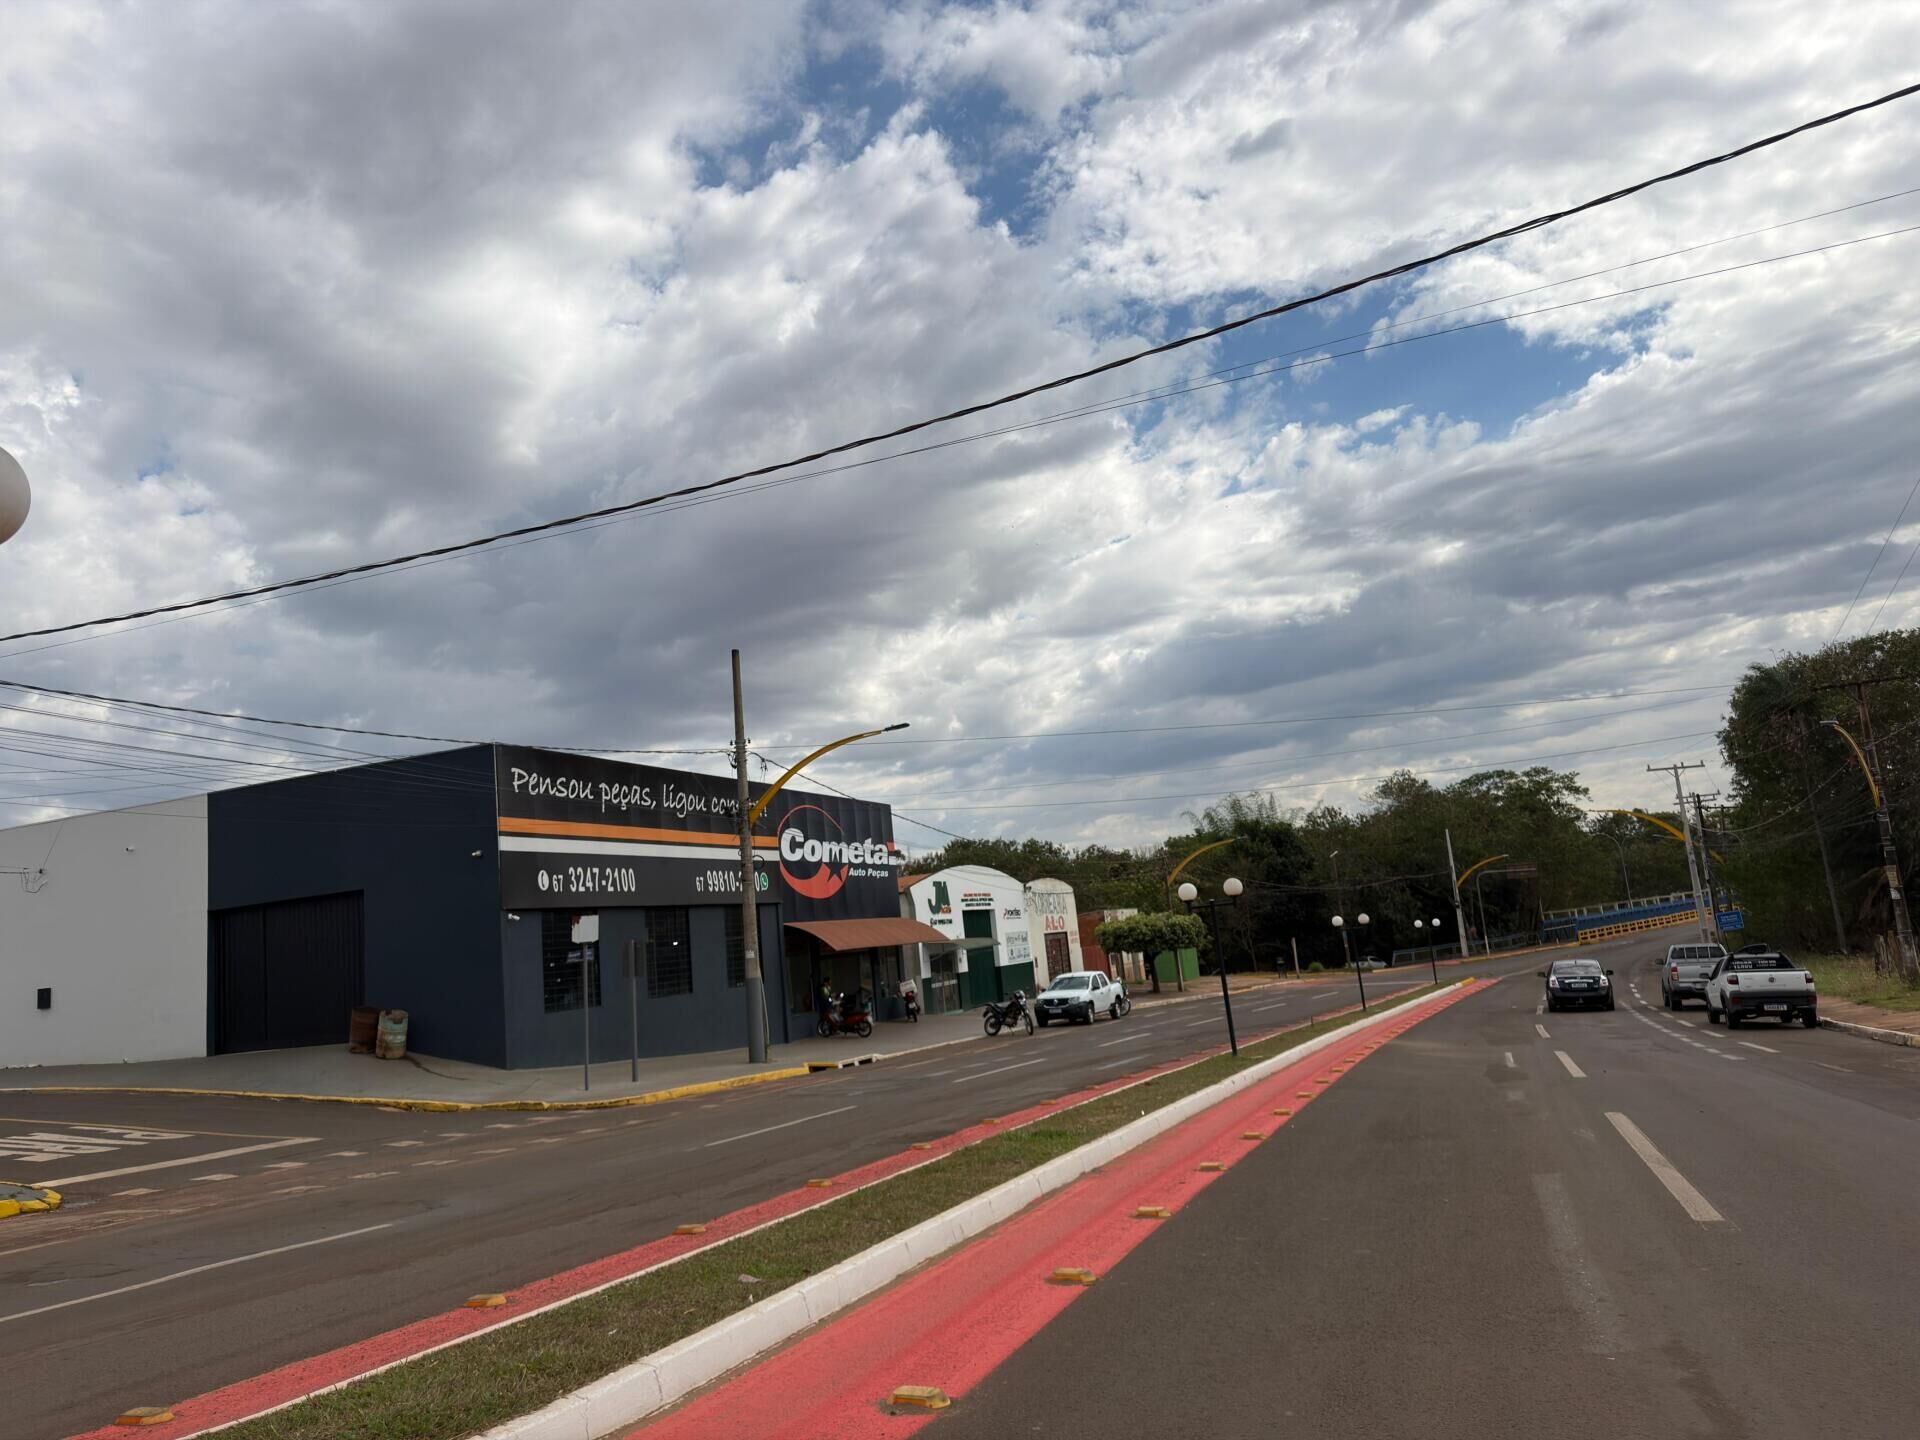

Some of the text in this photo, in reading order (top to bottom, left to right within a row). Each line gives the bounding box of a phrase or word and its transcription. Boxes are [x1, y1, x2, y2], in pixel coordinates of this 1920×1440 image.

[511, 767, 594, 799] Pensou
[599, 783, 657, 813] peças,
[662, 784, 707, 818] ligou
[780, 827, 889, 866] Cometa
[552, 867, 636, 892] 67 3247-2100
[696, 876, 704, 892] 67
[848, 867, 889, 878] Auto Peças
